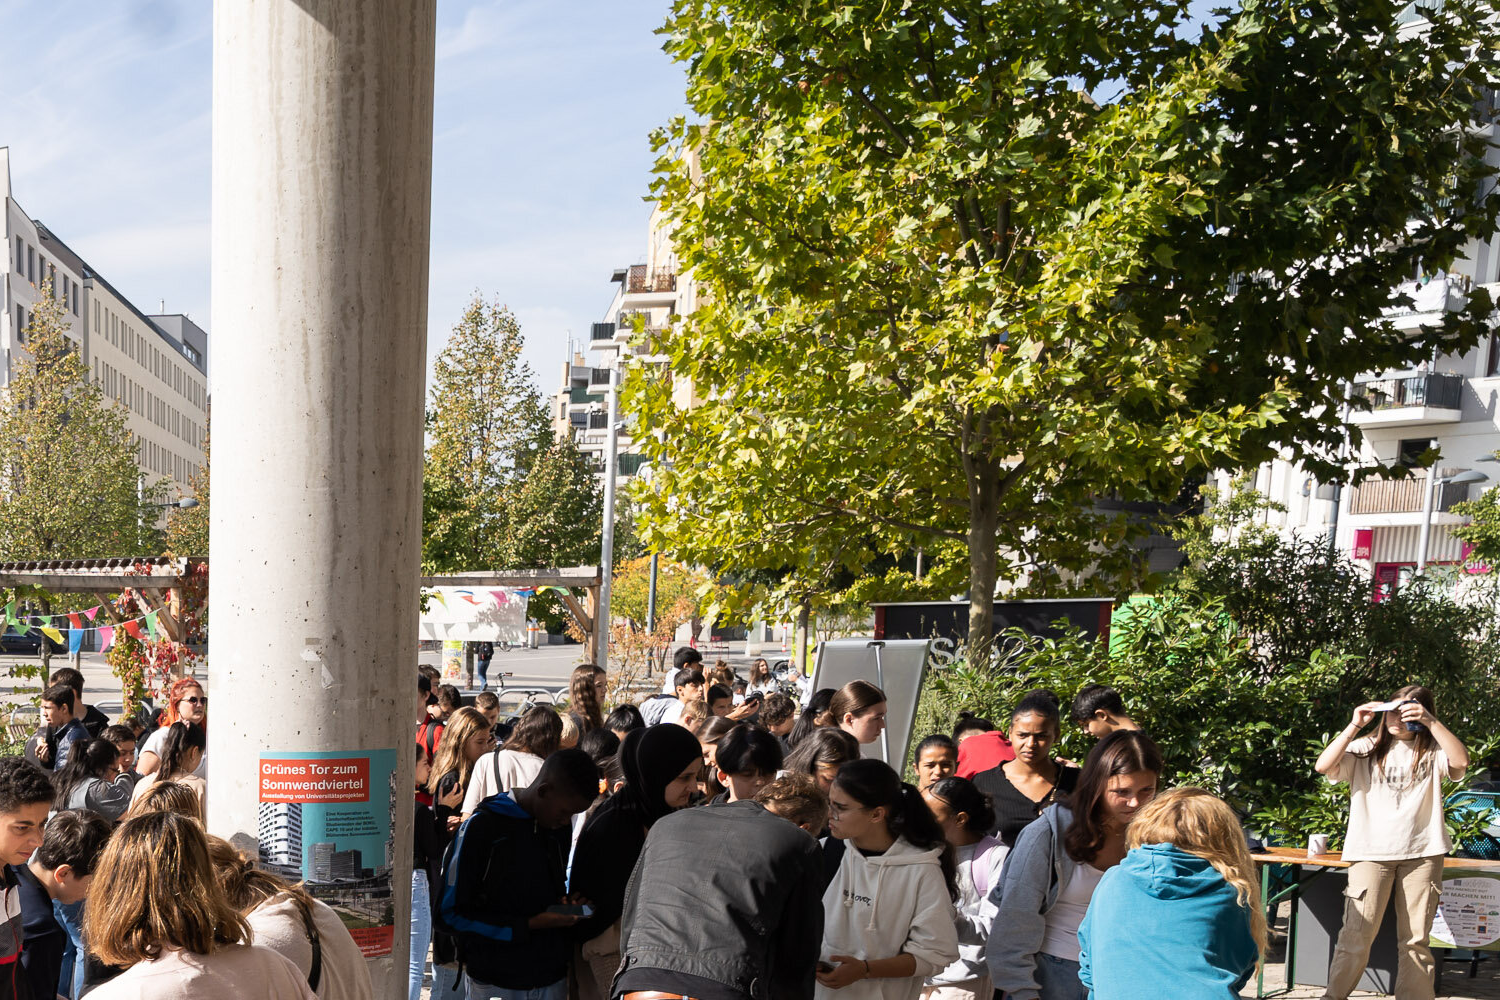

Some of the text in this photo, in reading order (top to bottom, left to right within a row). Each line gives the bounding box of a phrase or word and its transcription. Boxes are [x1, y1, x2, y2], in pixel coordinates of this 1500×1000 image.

[262, 764, 358, 774] Grünes Tor zum
[262, 778, 363, 790] Sonnwendviertel
